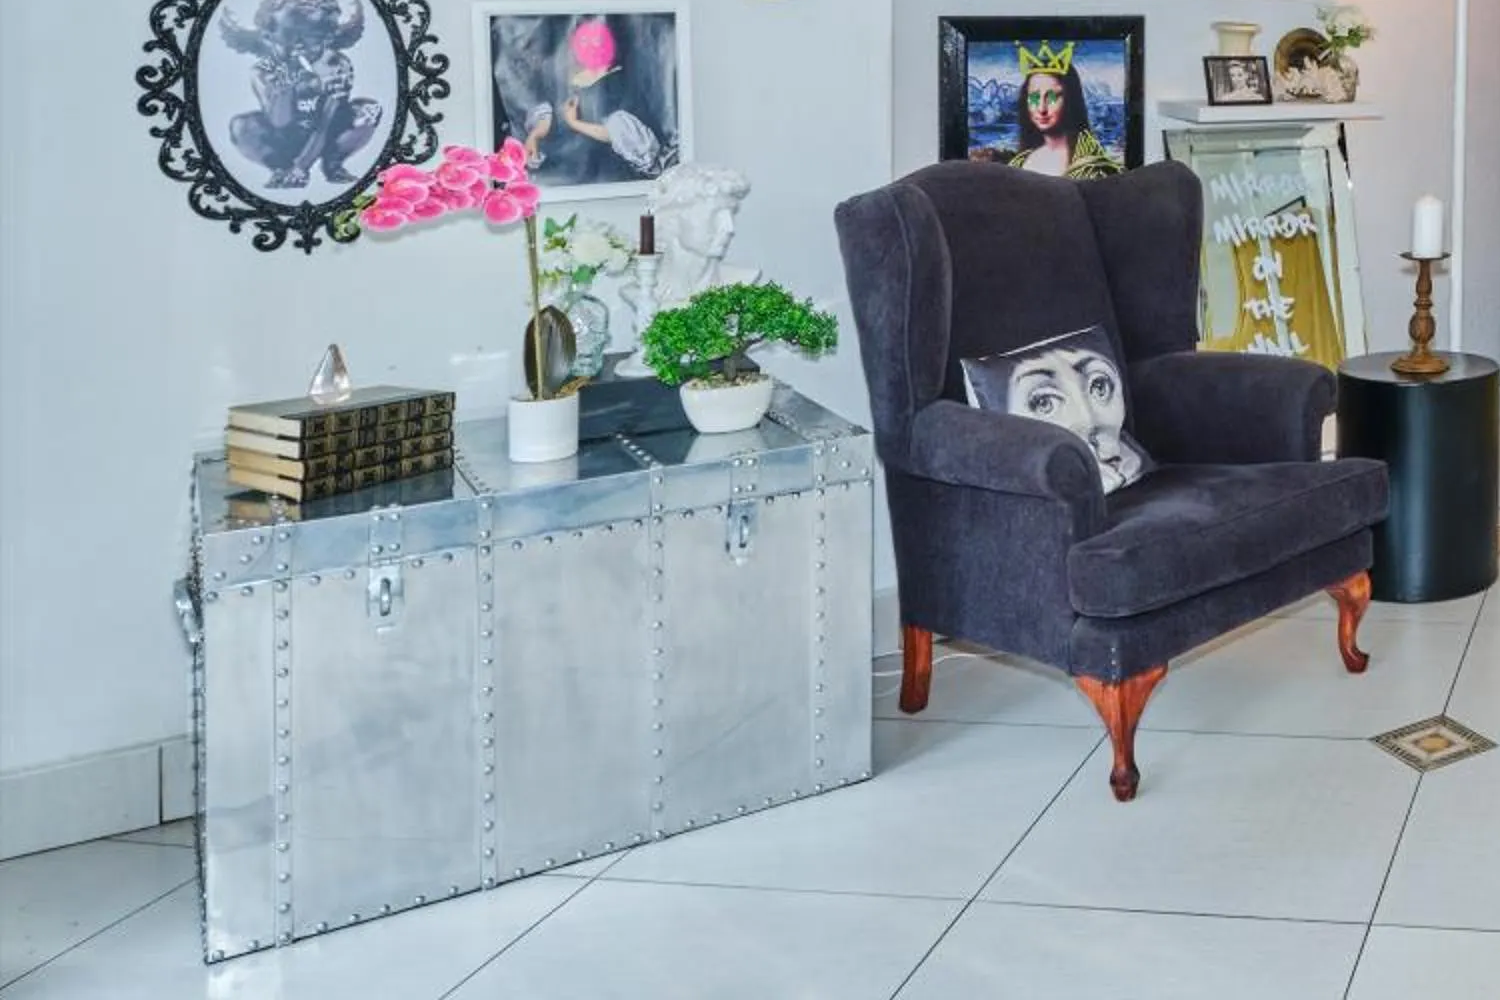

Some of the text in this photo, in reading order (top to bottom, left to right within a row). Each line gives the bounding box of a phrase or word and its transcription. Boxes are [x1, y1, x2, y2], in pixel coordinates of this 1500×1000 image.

[1213, 213, 1319, 247] MIRROR
[1252, 250, 1283, 281] ON
[1243, 297, 1295, 320] THE
